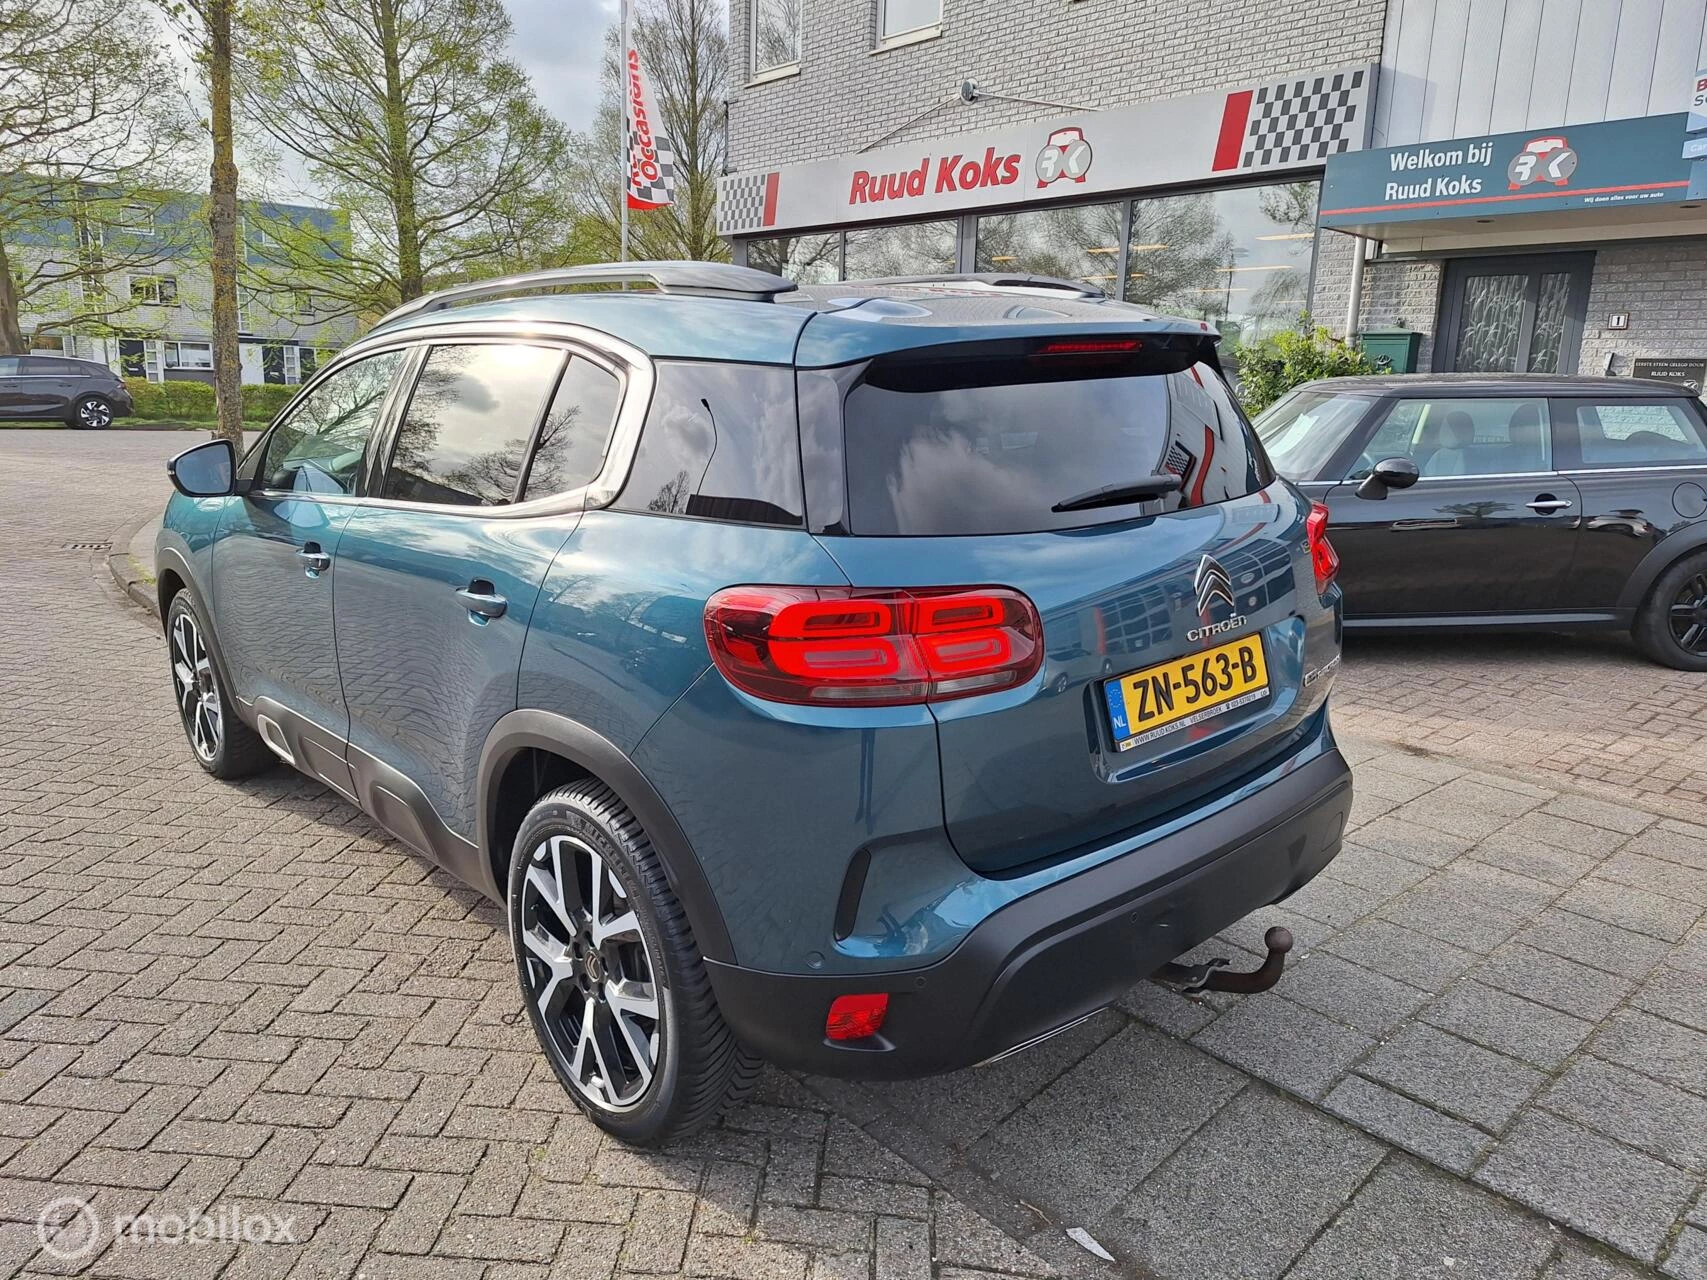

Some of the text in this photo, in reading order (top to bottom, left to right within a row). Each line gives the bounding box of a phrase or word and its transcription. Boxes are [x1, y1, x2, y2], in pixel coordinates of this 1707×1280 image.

[1390, 141, 1494, 172] Welkom bij
[849, 147, 1021, 205] Ruud Koks
[1385, 174, 1482, 201] Ruud Koks
[1133, 646, 1257, 722] ZN-563-B
[1113, 715, 1127, 728] NL
